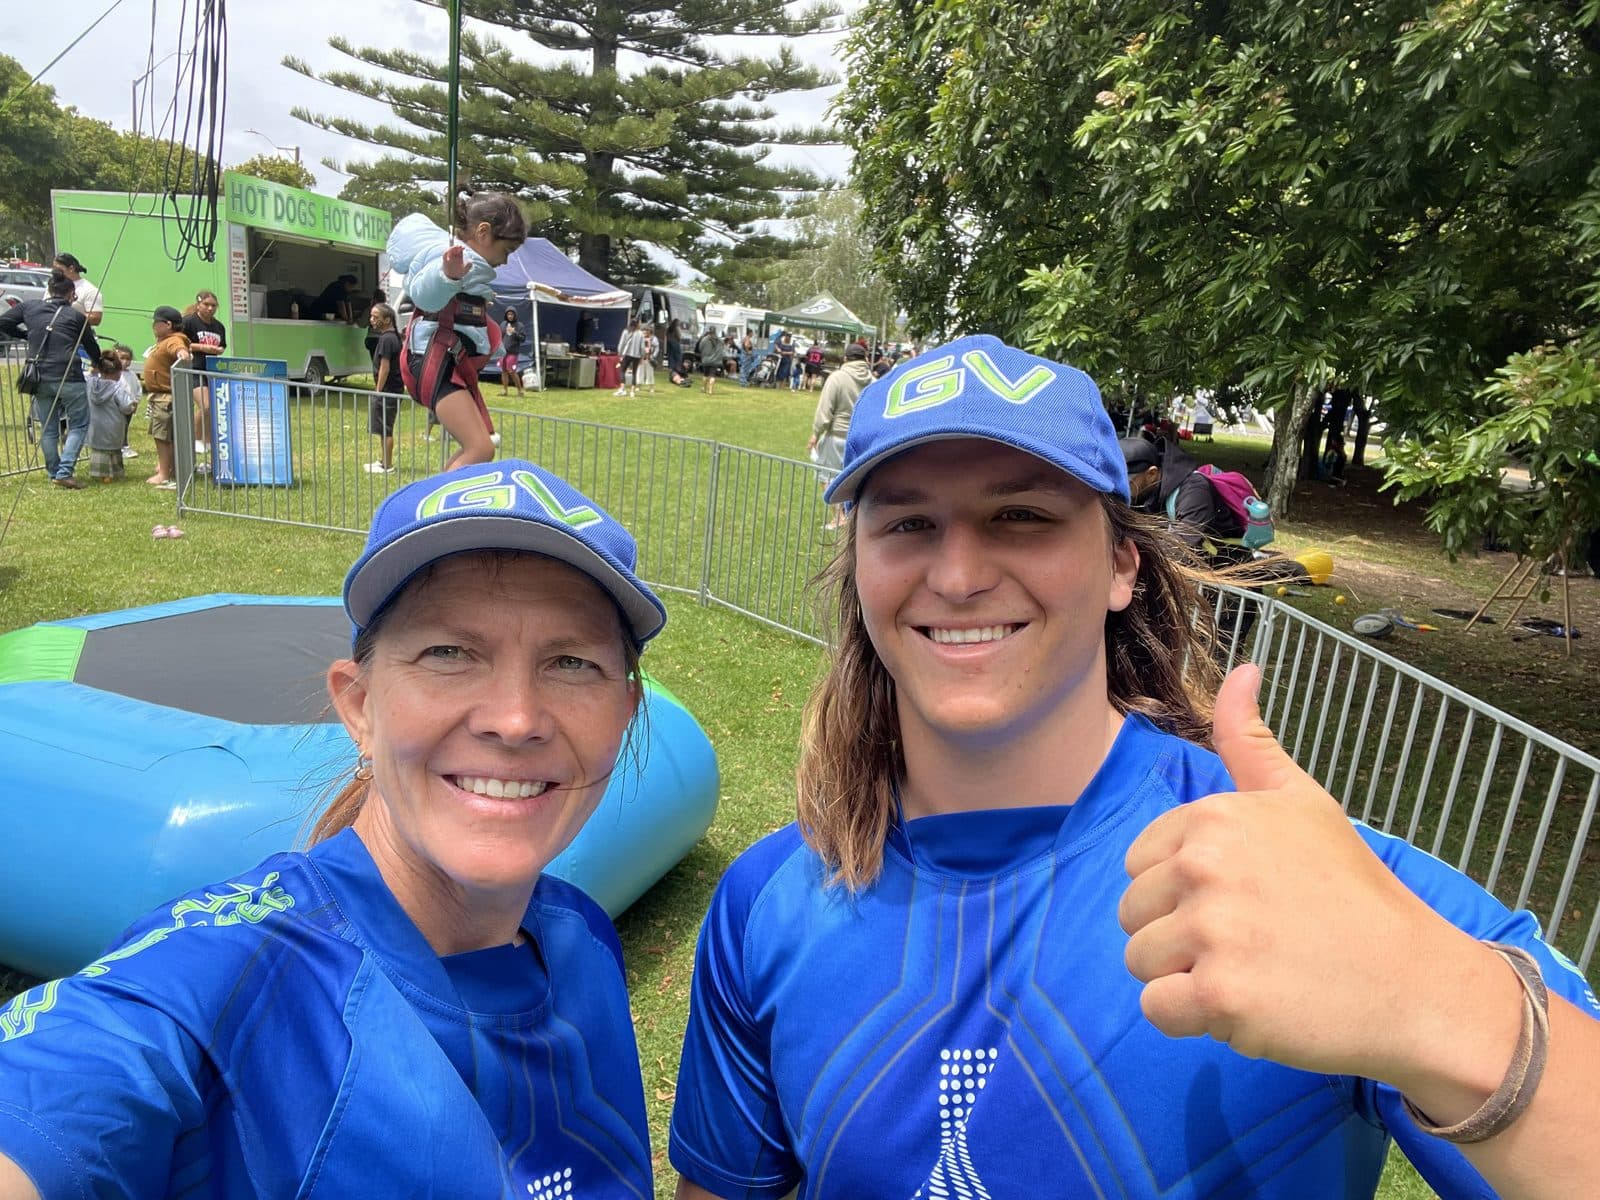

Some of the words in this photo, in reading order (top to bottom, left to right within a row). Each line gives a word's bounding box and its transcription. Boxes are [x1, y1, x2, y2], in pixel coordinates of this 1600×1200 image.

[231, 181, 268, 219] HOT
[274, 190, 317, 228] DOGS
[322, 204, 350, 236] HOT
[353, 210, 389, 241] CHIPS
[216, 383, 229, 440] VERTICAL
[883, 350, 1057, 419] GV
[218, 442, 229, 460] GO
[416, 470, 603, 530] GV
